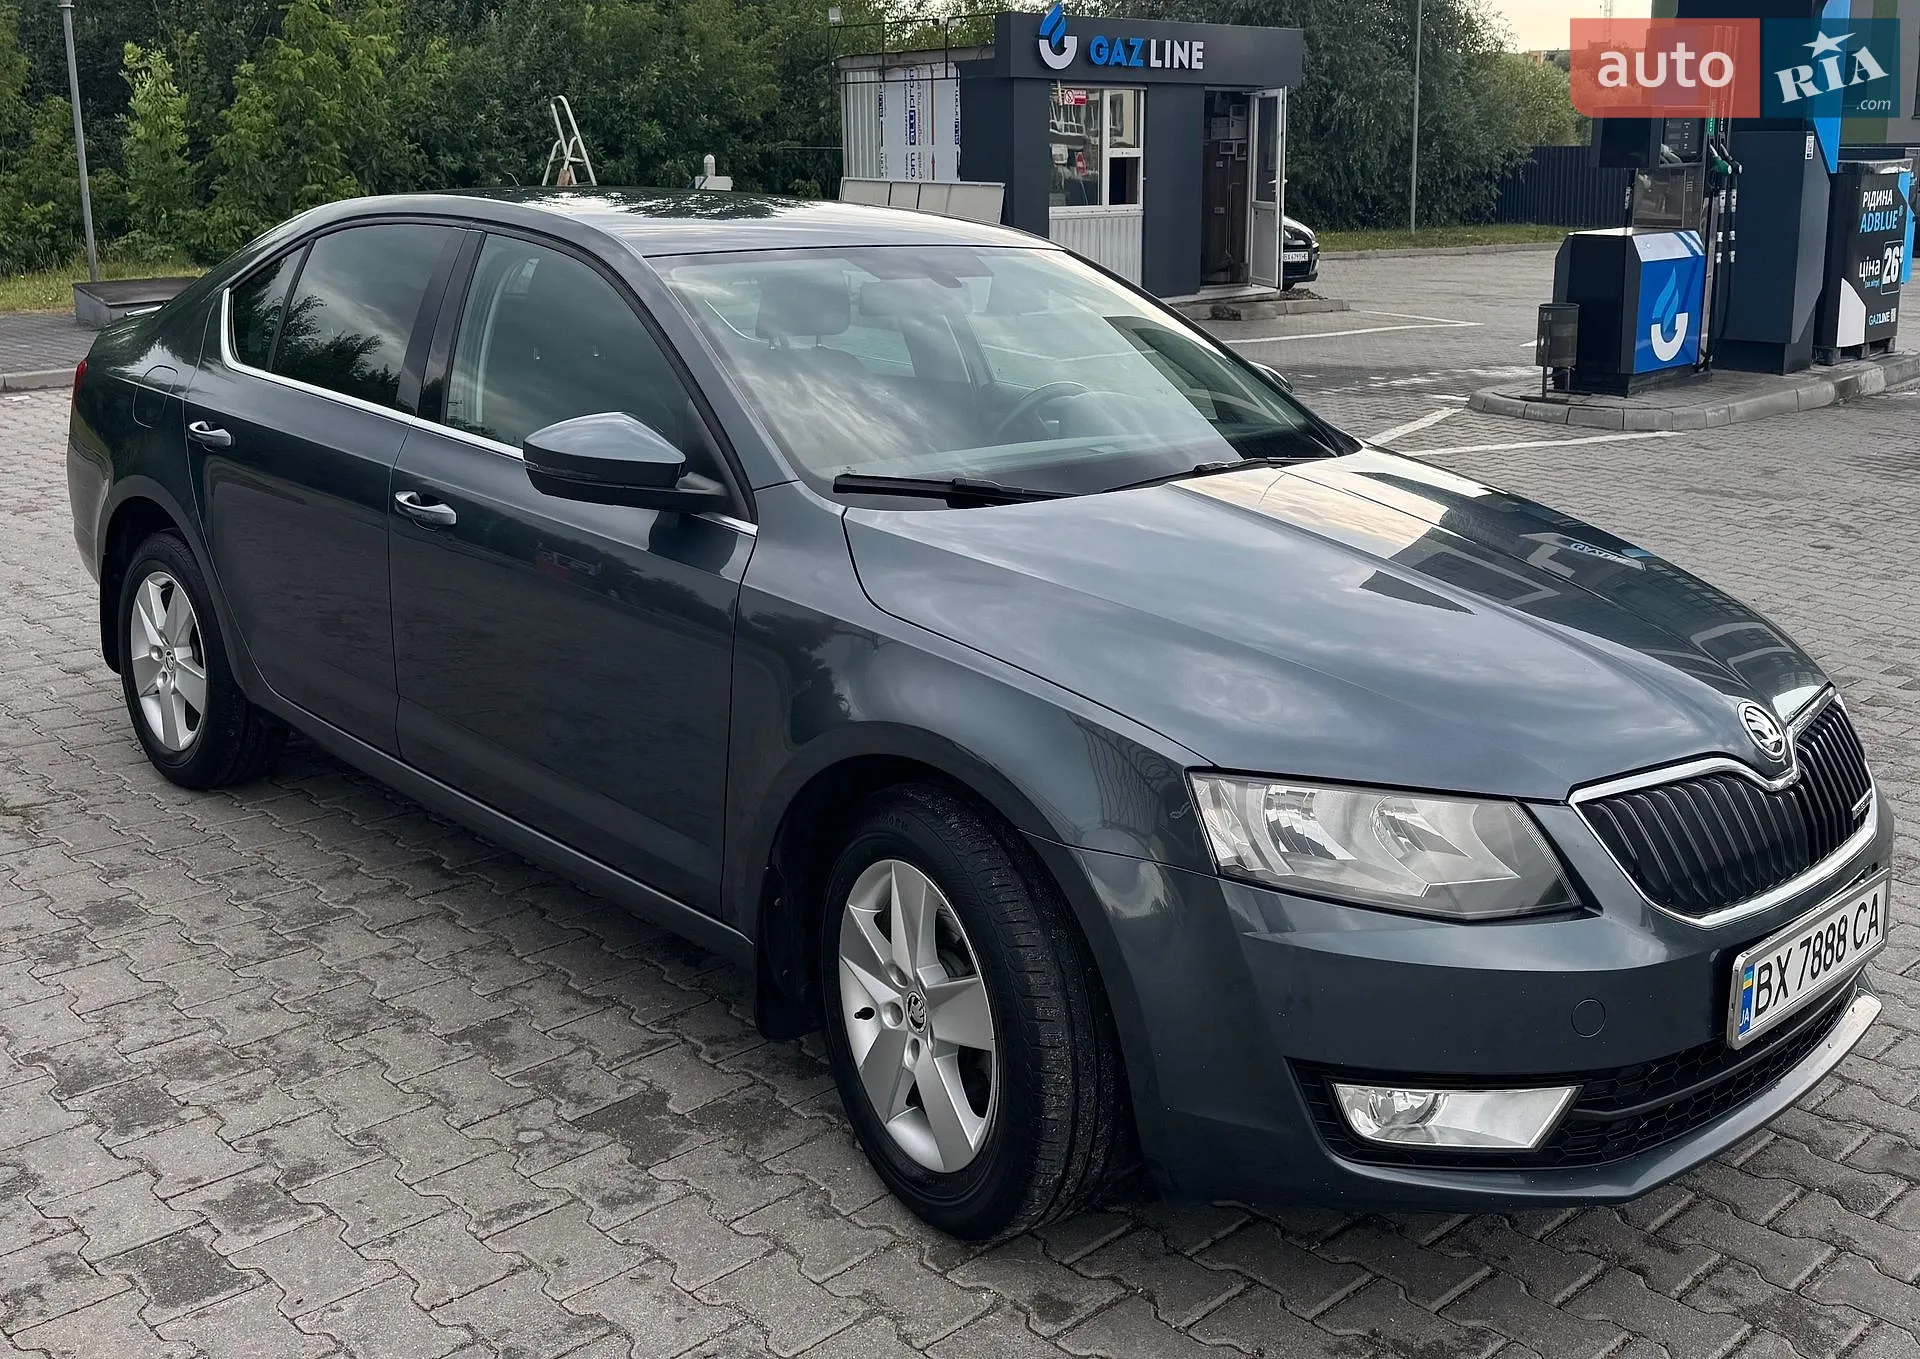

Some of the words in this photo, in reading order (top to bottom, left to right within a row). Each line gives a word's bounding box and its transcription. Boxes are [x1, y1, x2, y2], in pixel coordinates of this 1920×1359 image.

[1089, 35, 1144, 67] GAZ
[1150, 39, 1204, 69] LINE
[1862, 189, 1893, 211] РІДИНА
[1859, 256, 1881, 282] ціна
[1754, 947, 1793, 1018] BX
[1796, 914, 1848, 991] 7888
[1853, 892, 1879, 950] CA
